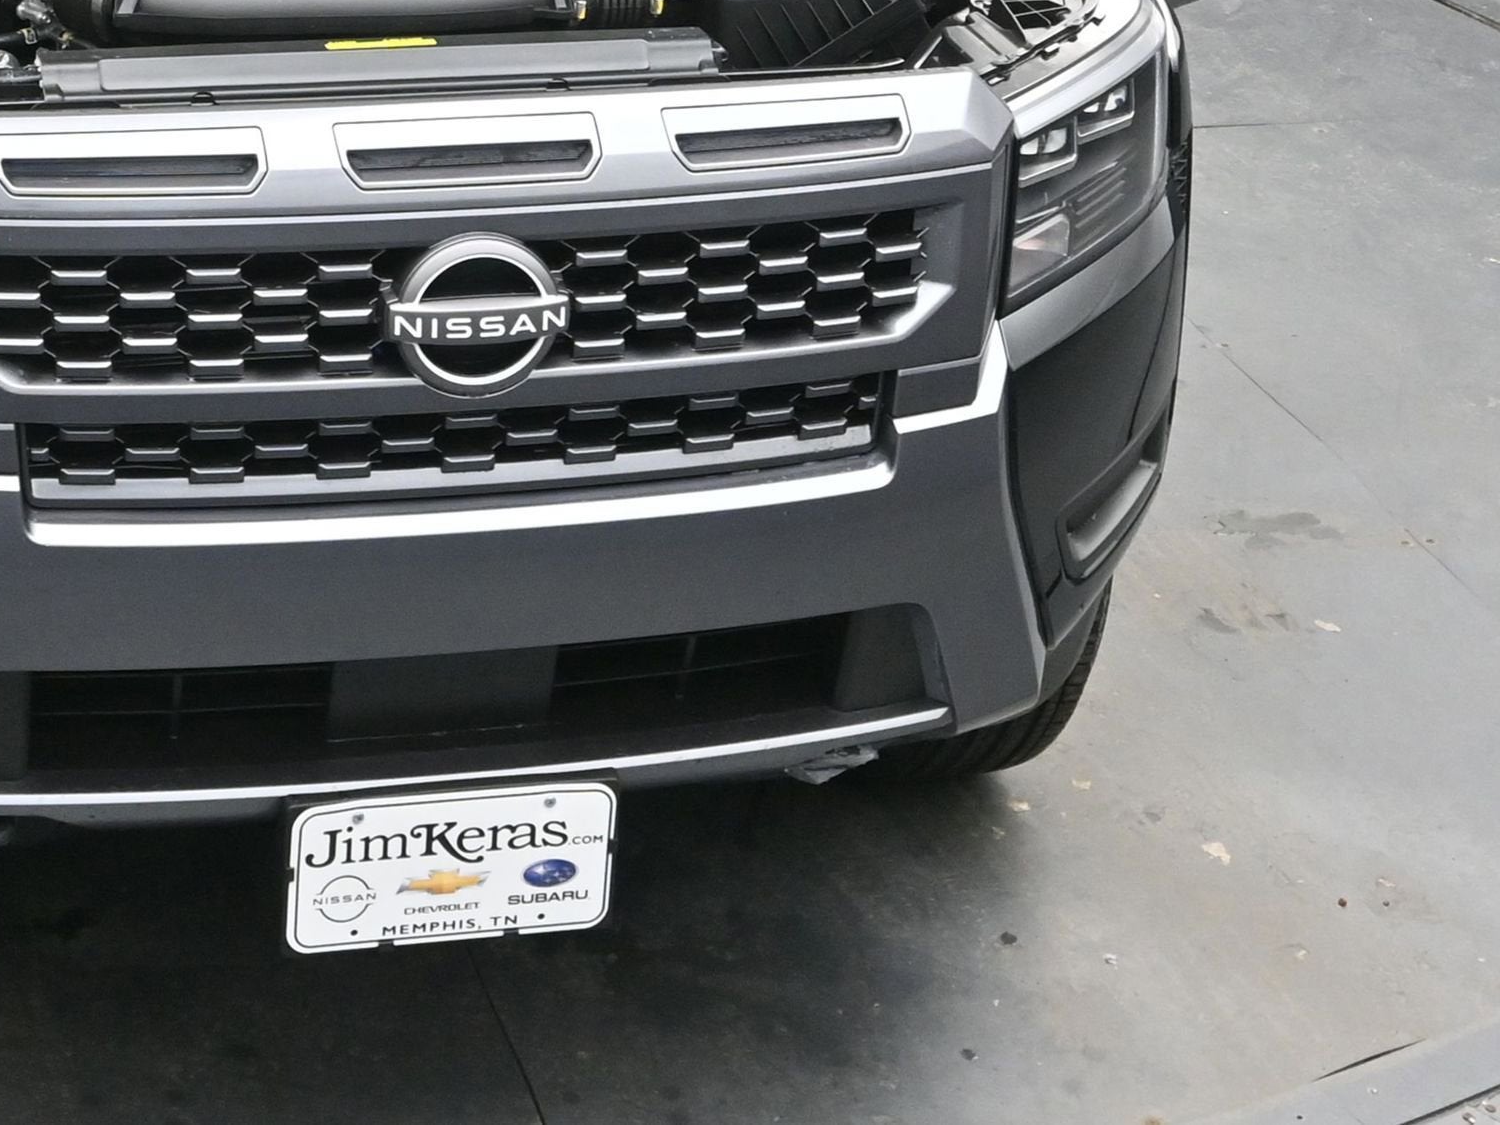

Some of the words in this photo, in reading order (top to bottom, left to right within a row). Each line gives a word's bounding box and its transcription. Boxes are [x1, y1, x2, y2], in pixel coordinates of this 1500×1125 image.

[394, 306, 566, 339] NISSAN
[312, 893, 377, 906] NISSAN
[507, 889, 589, 905] SUBARU
[404, 902, 481, 916] CHEVROLET
[382, 918, 482, 937] MEMPHIS,
[490, 915, 518, 927] TN
